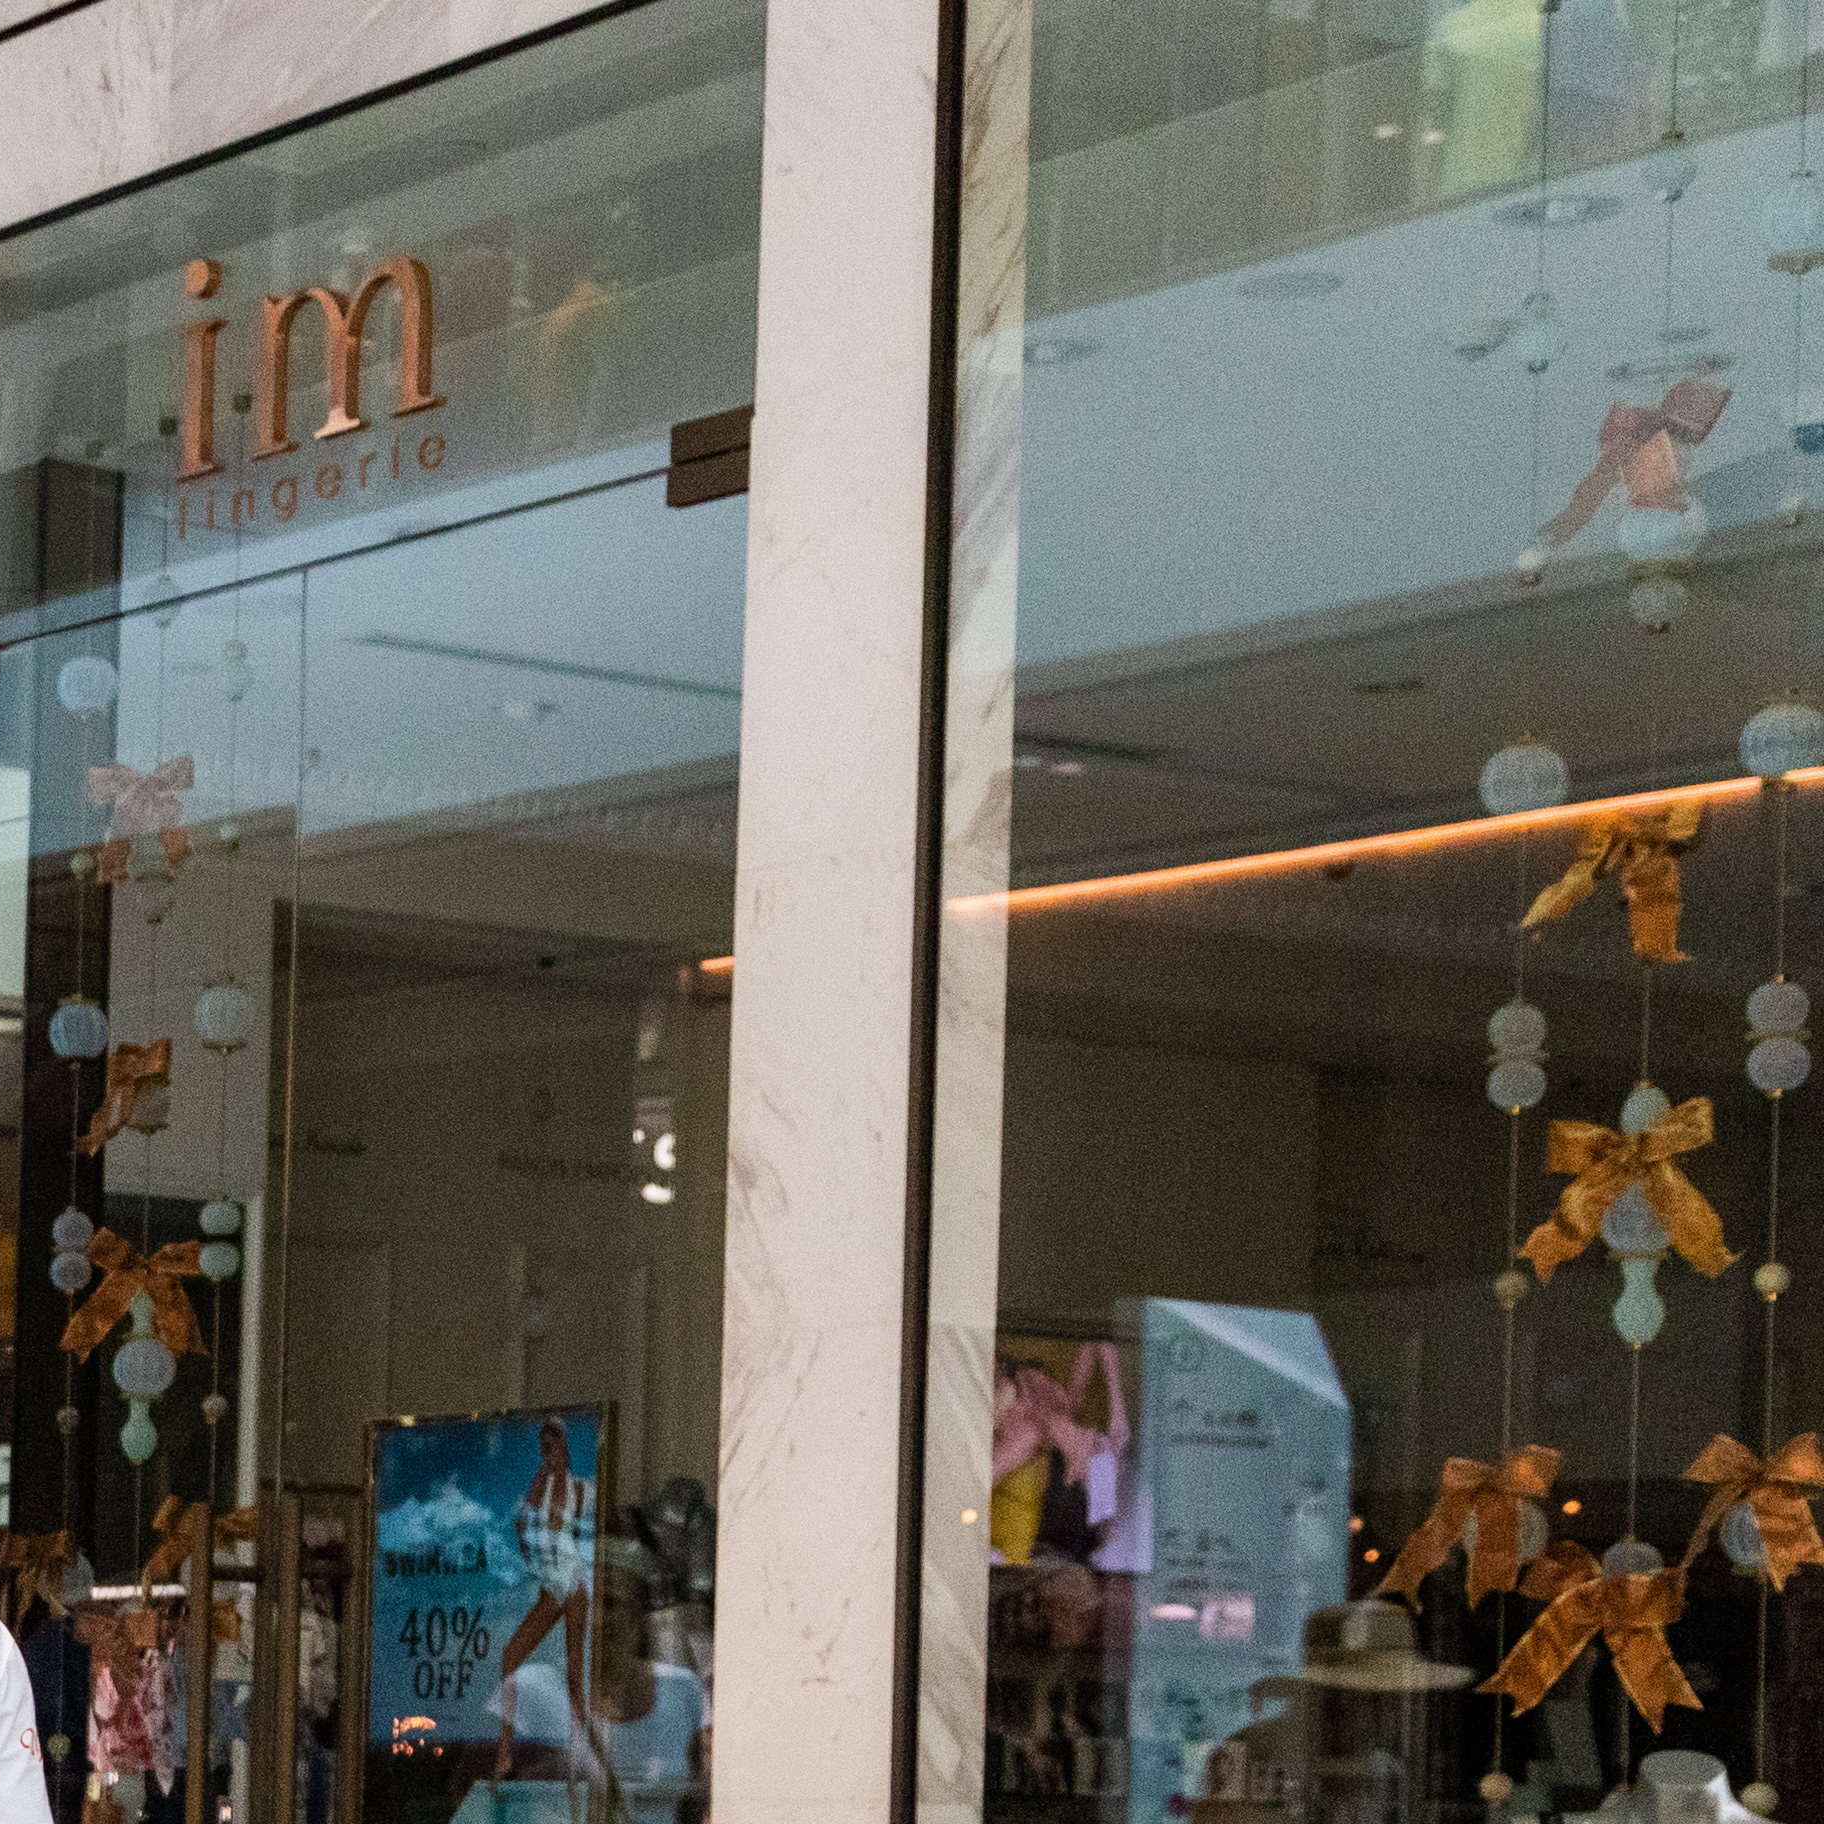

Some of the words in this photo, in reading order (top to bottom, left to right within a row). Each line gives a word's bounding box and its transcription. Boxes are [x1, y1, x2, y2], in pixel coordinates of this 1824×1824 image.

[178, 255, 448, 484] im
[178, 434, 446, 540] lingerie
[399, 1607, 490, 1660] 40%
[414, 1660, 474, 1699] OFF
